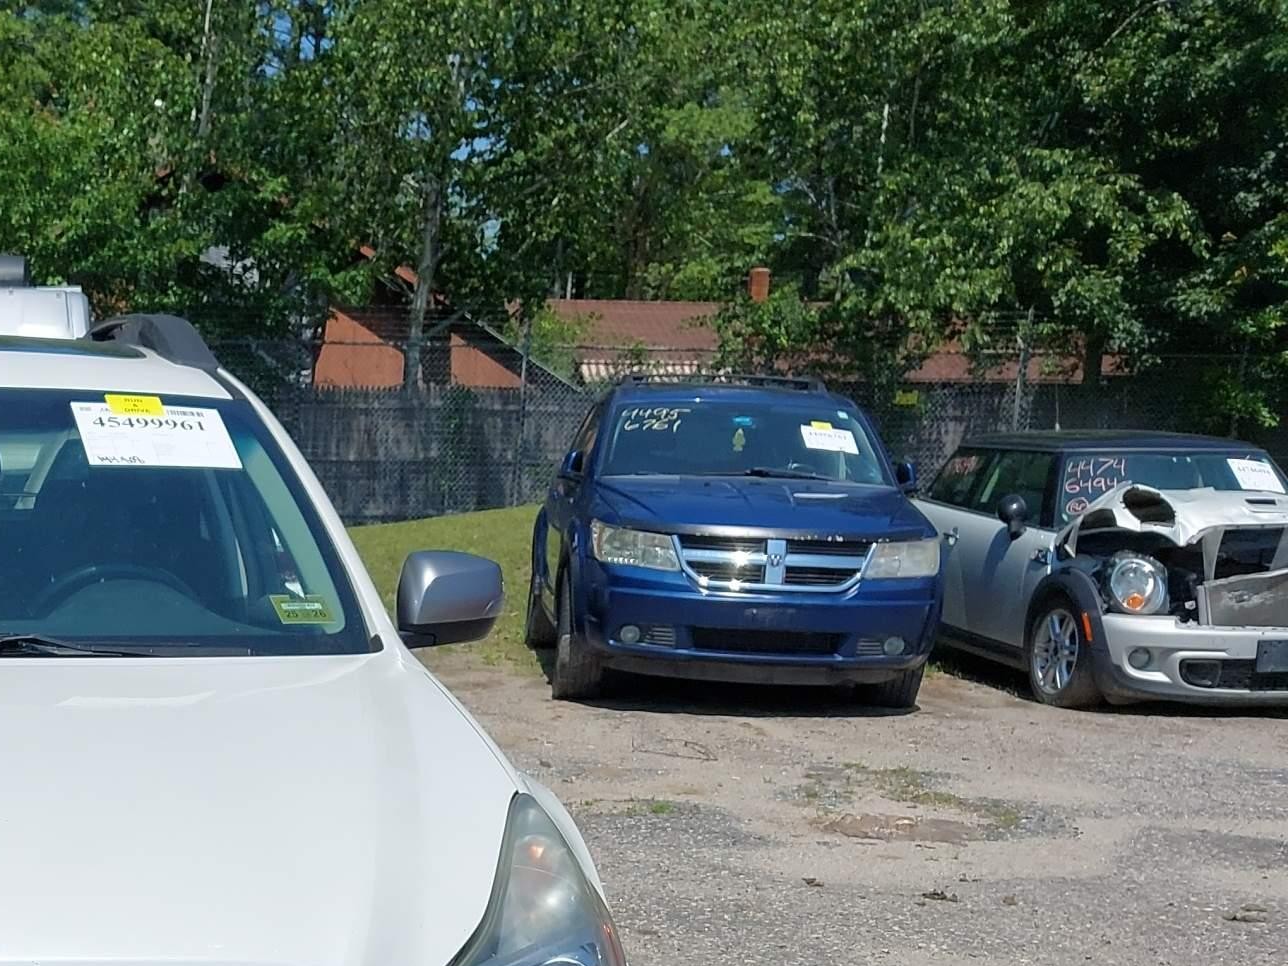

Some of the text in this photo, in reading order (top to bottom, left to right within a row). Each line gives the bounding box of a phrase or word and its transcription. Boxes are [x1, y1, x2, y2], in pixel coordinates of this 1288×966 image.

[622, 408, 690, 419] 4495
[92, 416, 206, 431] 45499961
[1068, 458, 1124, 478] 4474
[1065, 477, 1117, 493] 6494
